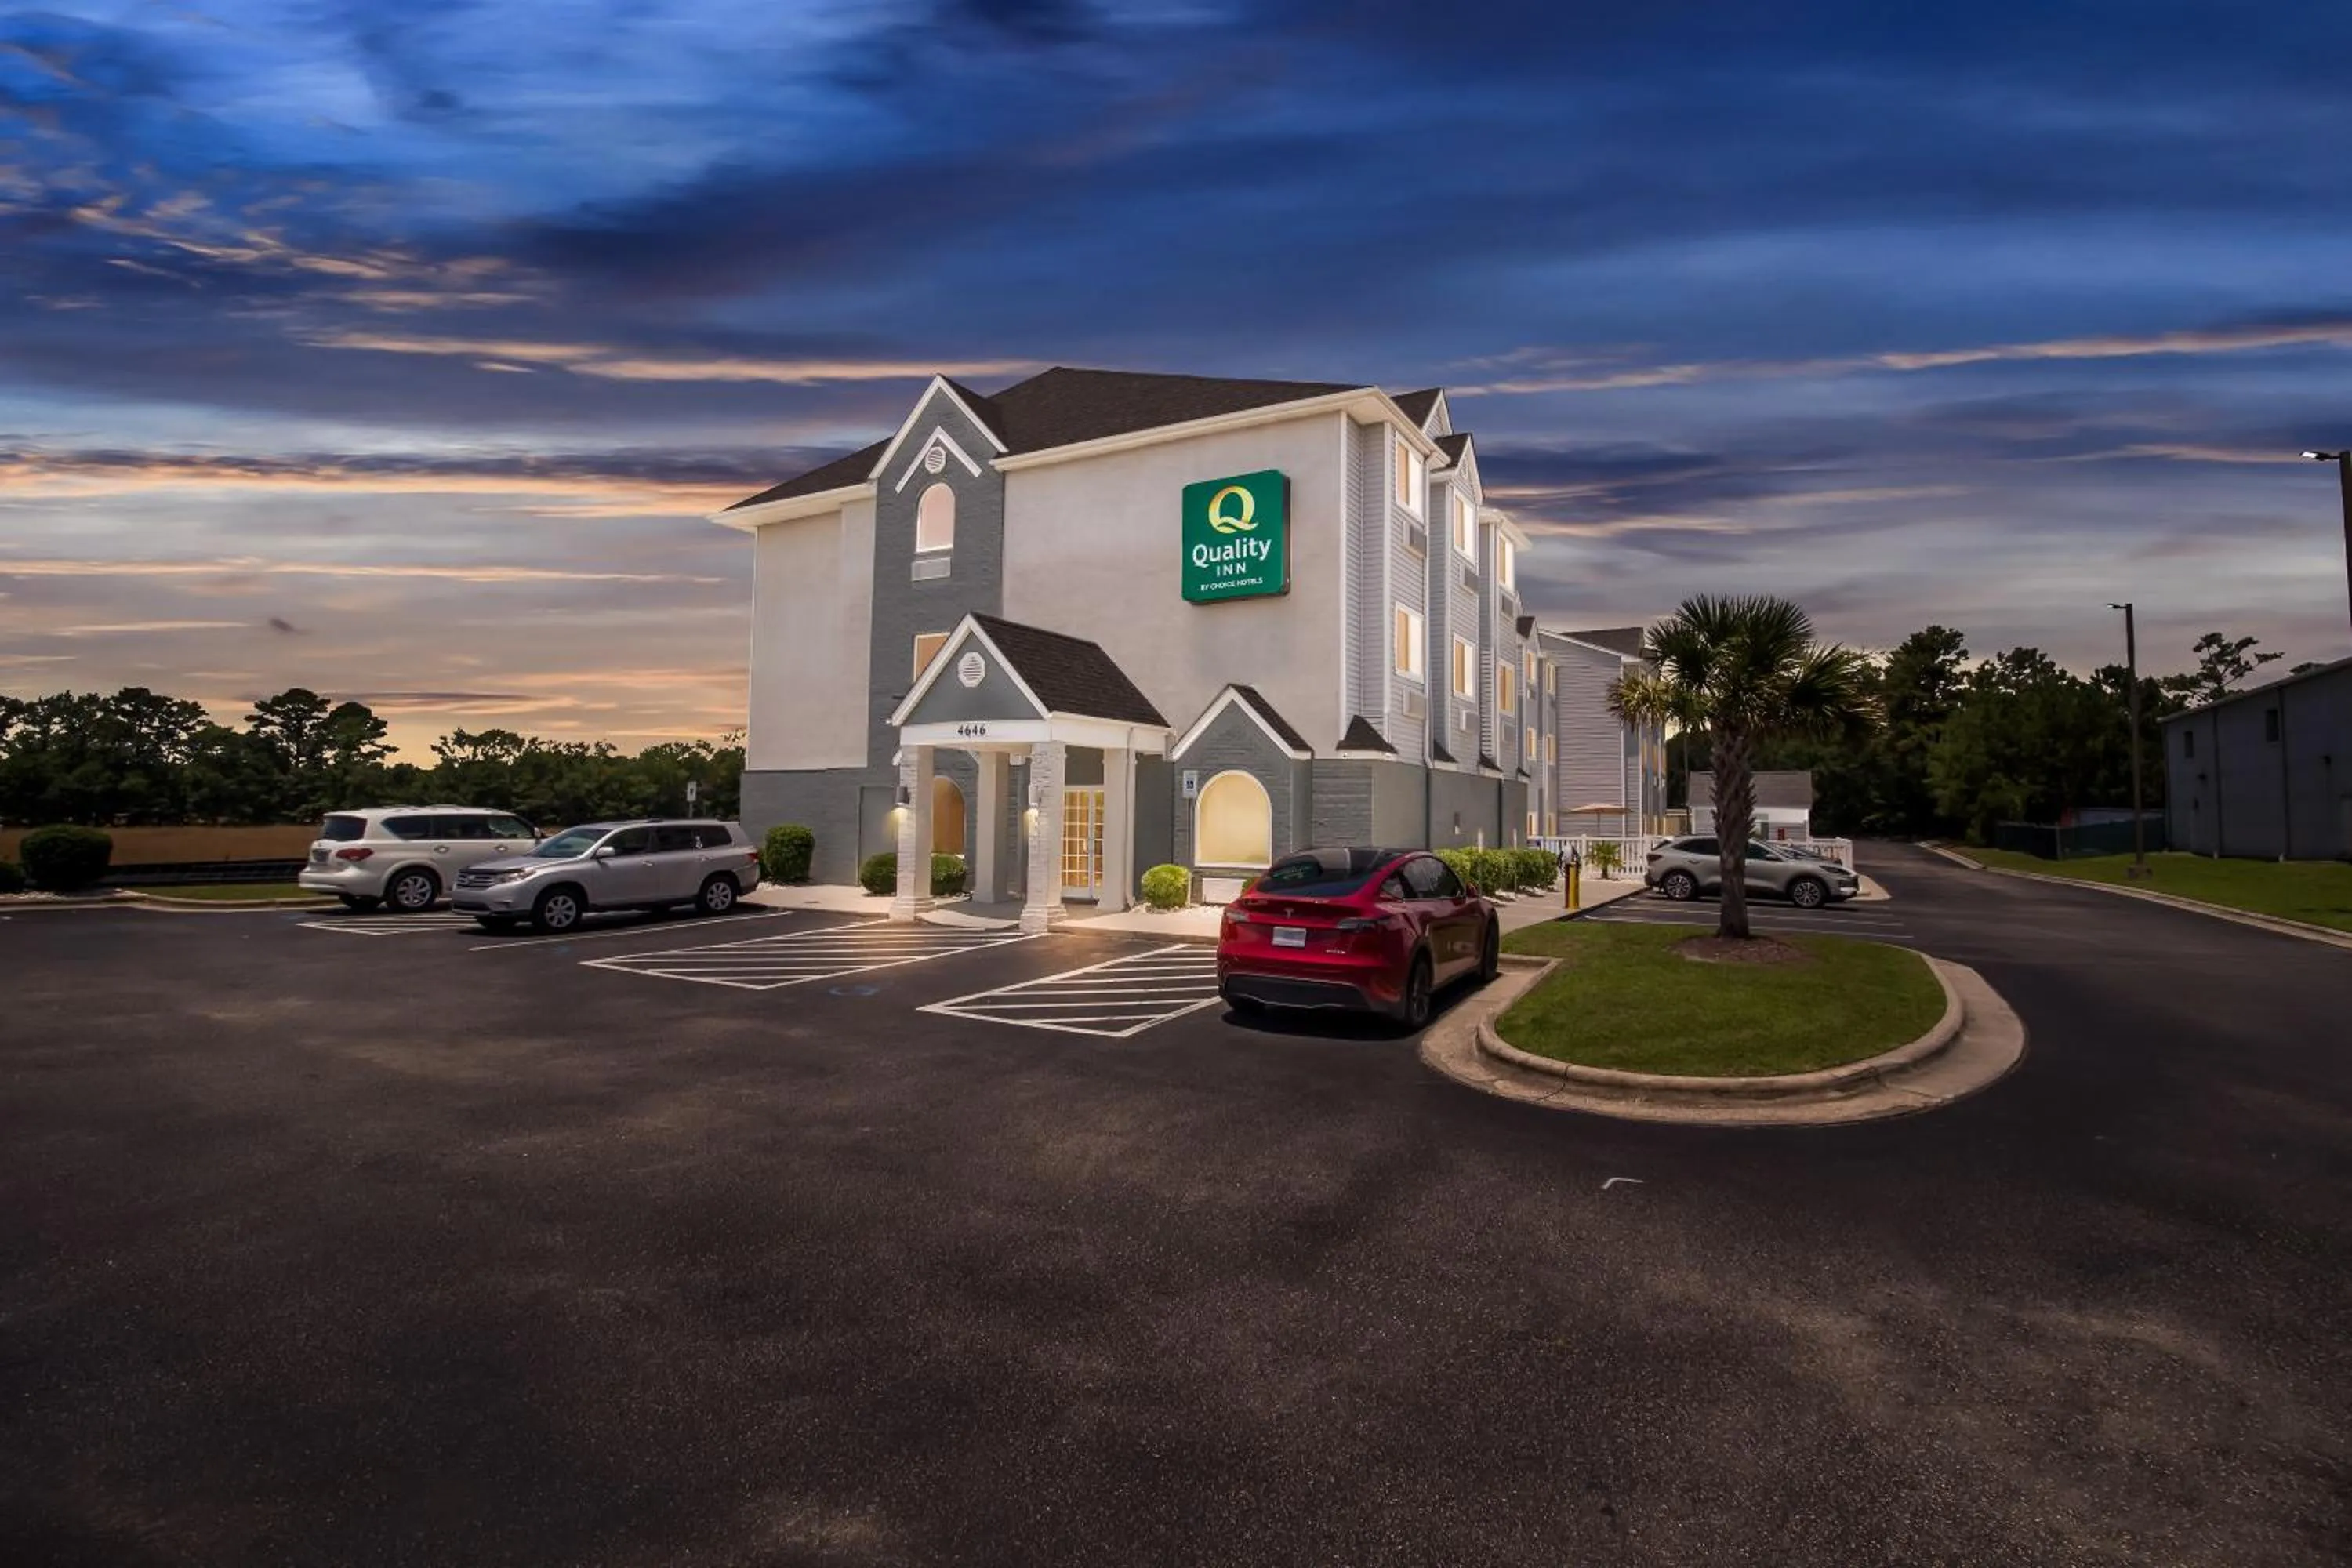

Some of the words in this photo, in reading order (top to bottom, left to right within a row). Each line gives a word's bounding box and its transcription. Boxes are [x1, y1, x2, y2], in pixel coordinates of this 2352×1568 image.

[1208, 485, 1258, 534] Q
[1192, 537, 1272, 568] Quality
[1216, 561, 1247, 577] INN
[1236, 576, 1263, 587] HOTELS
[957, 724, 986, 736] 4646
